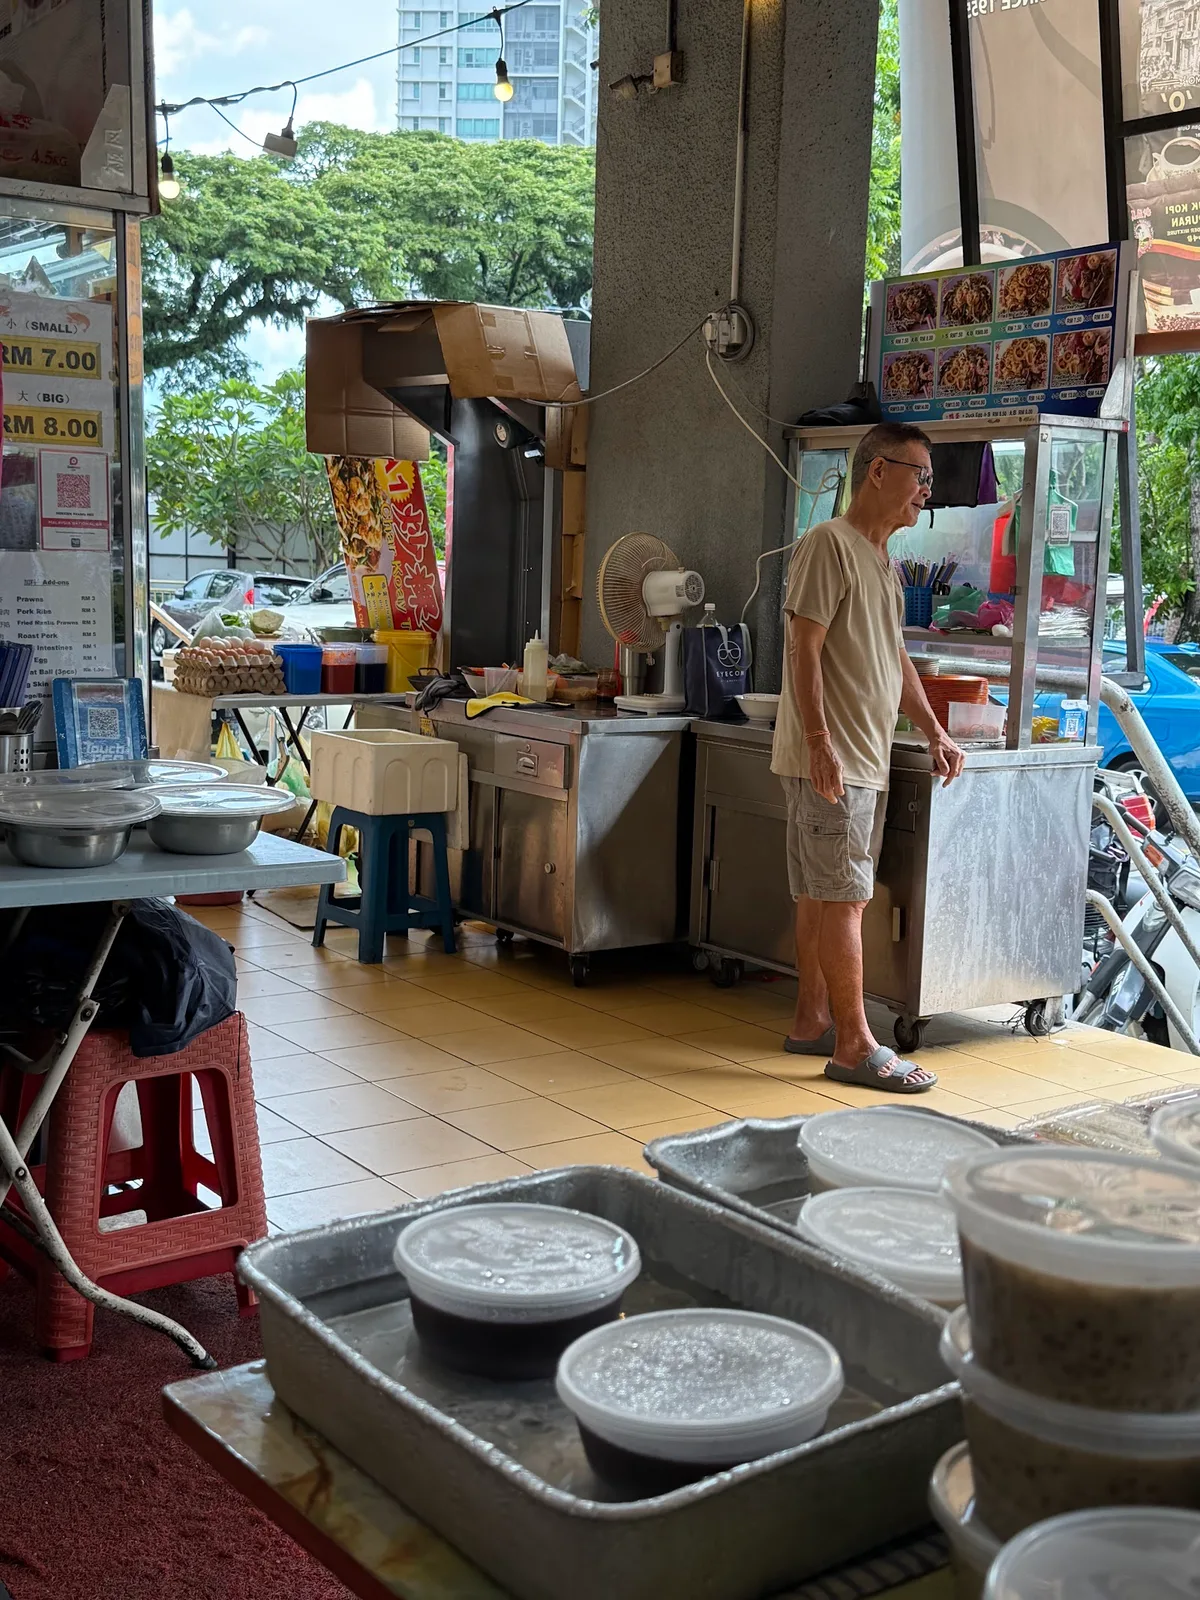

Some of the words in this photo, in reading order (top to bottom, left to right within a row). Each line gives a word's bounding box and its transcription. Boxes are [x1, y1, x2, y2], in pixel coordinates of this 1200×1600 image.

[6, 318, 17, 330] 小
[42, 348, 96, 371] 7.00
[18, 390, 29, 402] 大
[44, 417, 98, 438] 8.00
[381, 503, 397, 560] Char
[391, 560, 408, 614] Koay
[55, 668, 77, 676] (3pcs)
